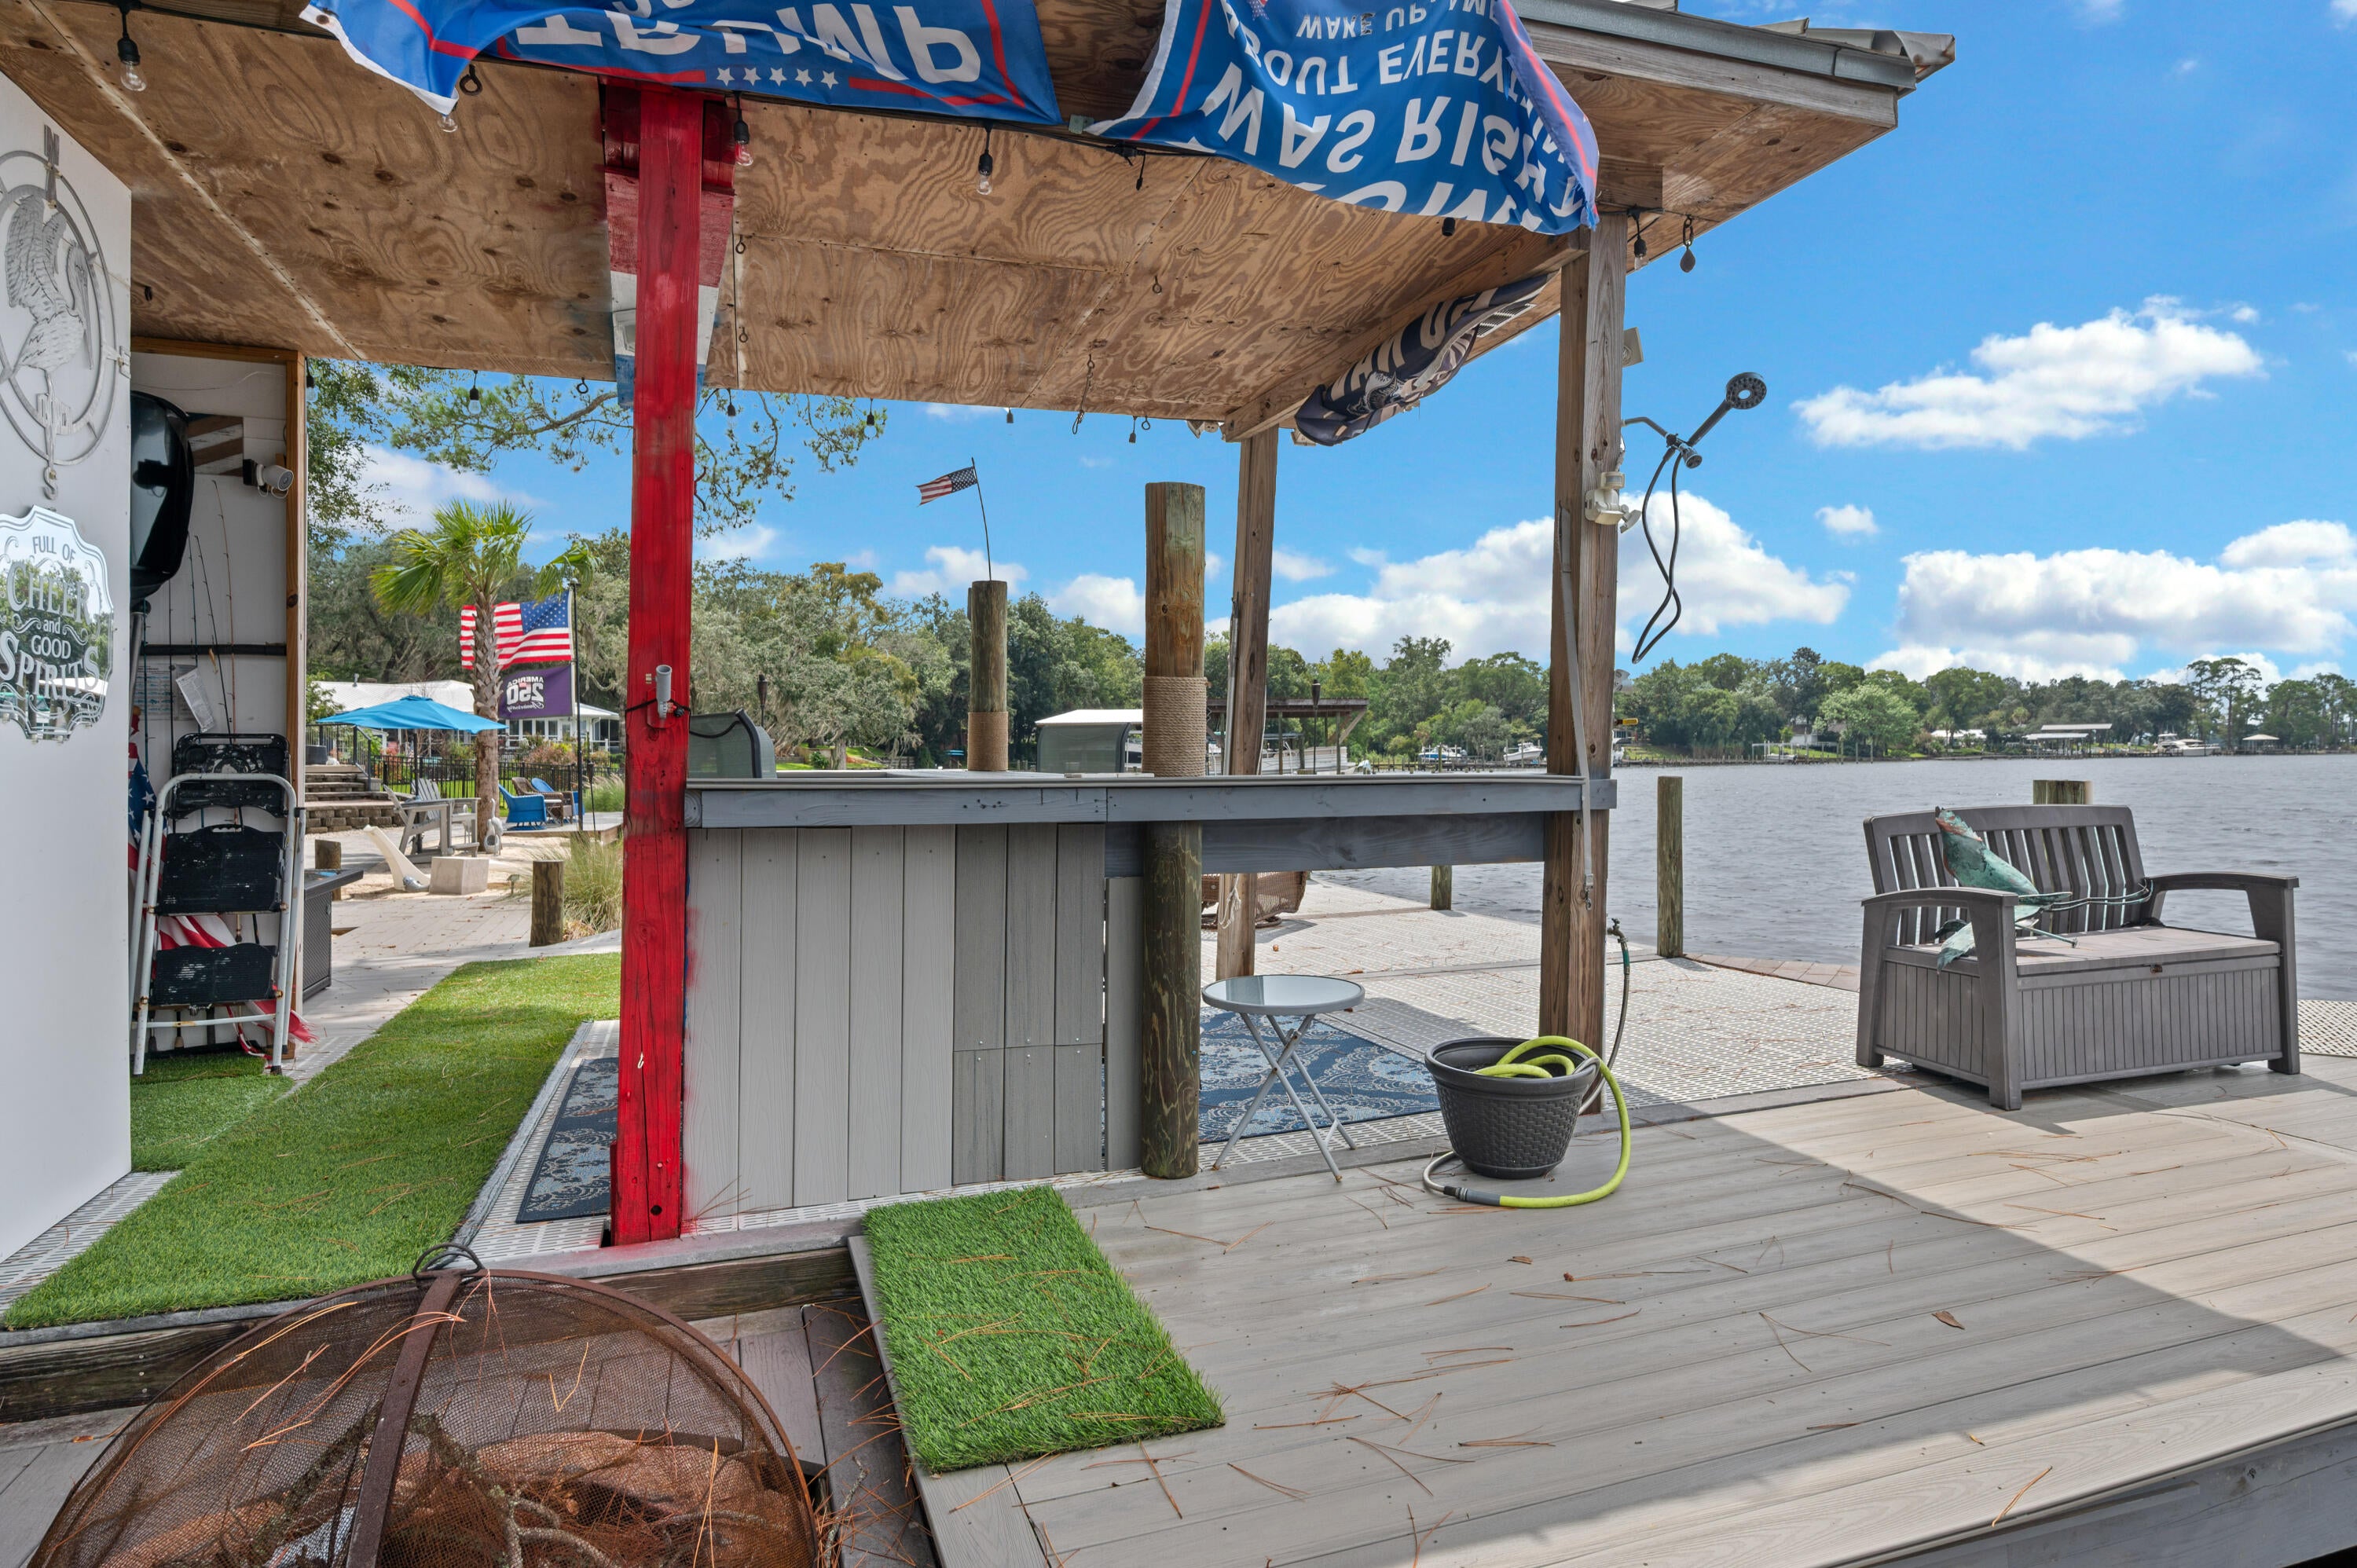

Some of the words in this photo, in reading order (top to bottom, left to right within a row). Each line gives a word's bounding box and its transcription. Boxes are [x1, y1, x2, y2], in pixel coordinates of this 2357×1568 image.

[32, 535, 57, 554] FULL
[62, 544, 76, 564] OF
[6, 559, 91, 625] CHEER
[43, 617, 61, 634] and
[31, 635, 71, 659] GOOD
[0, 631, 100, 700] SPIRITS
